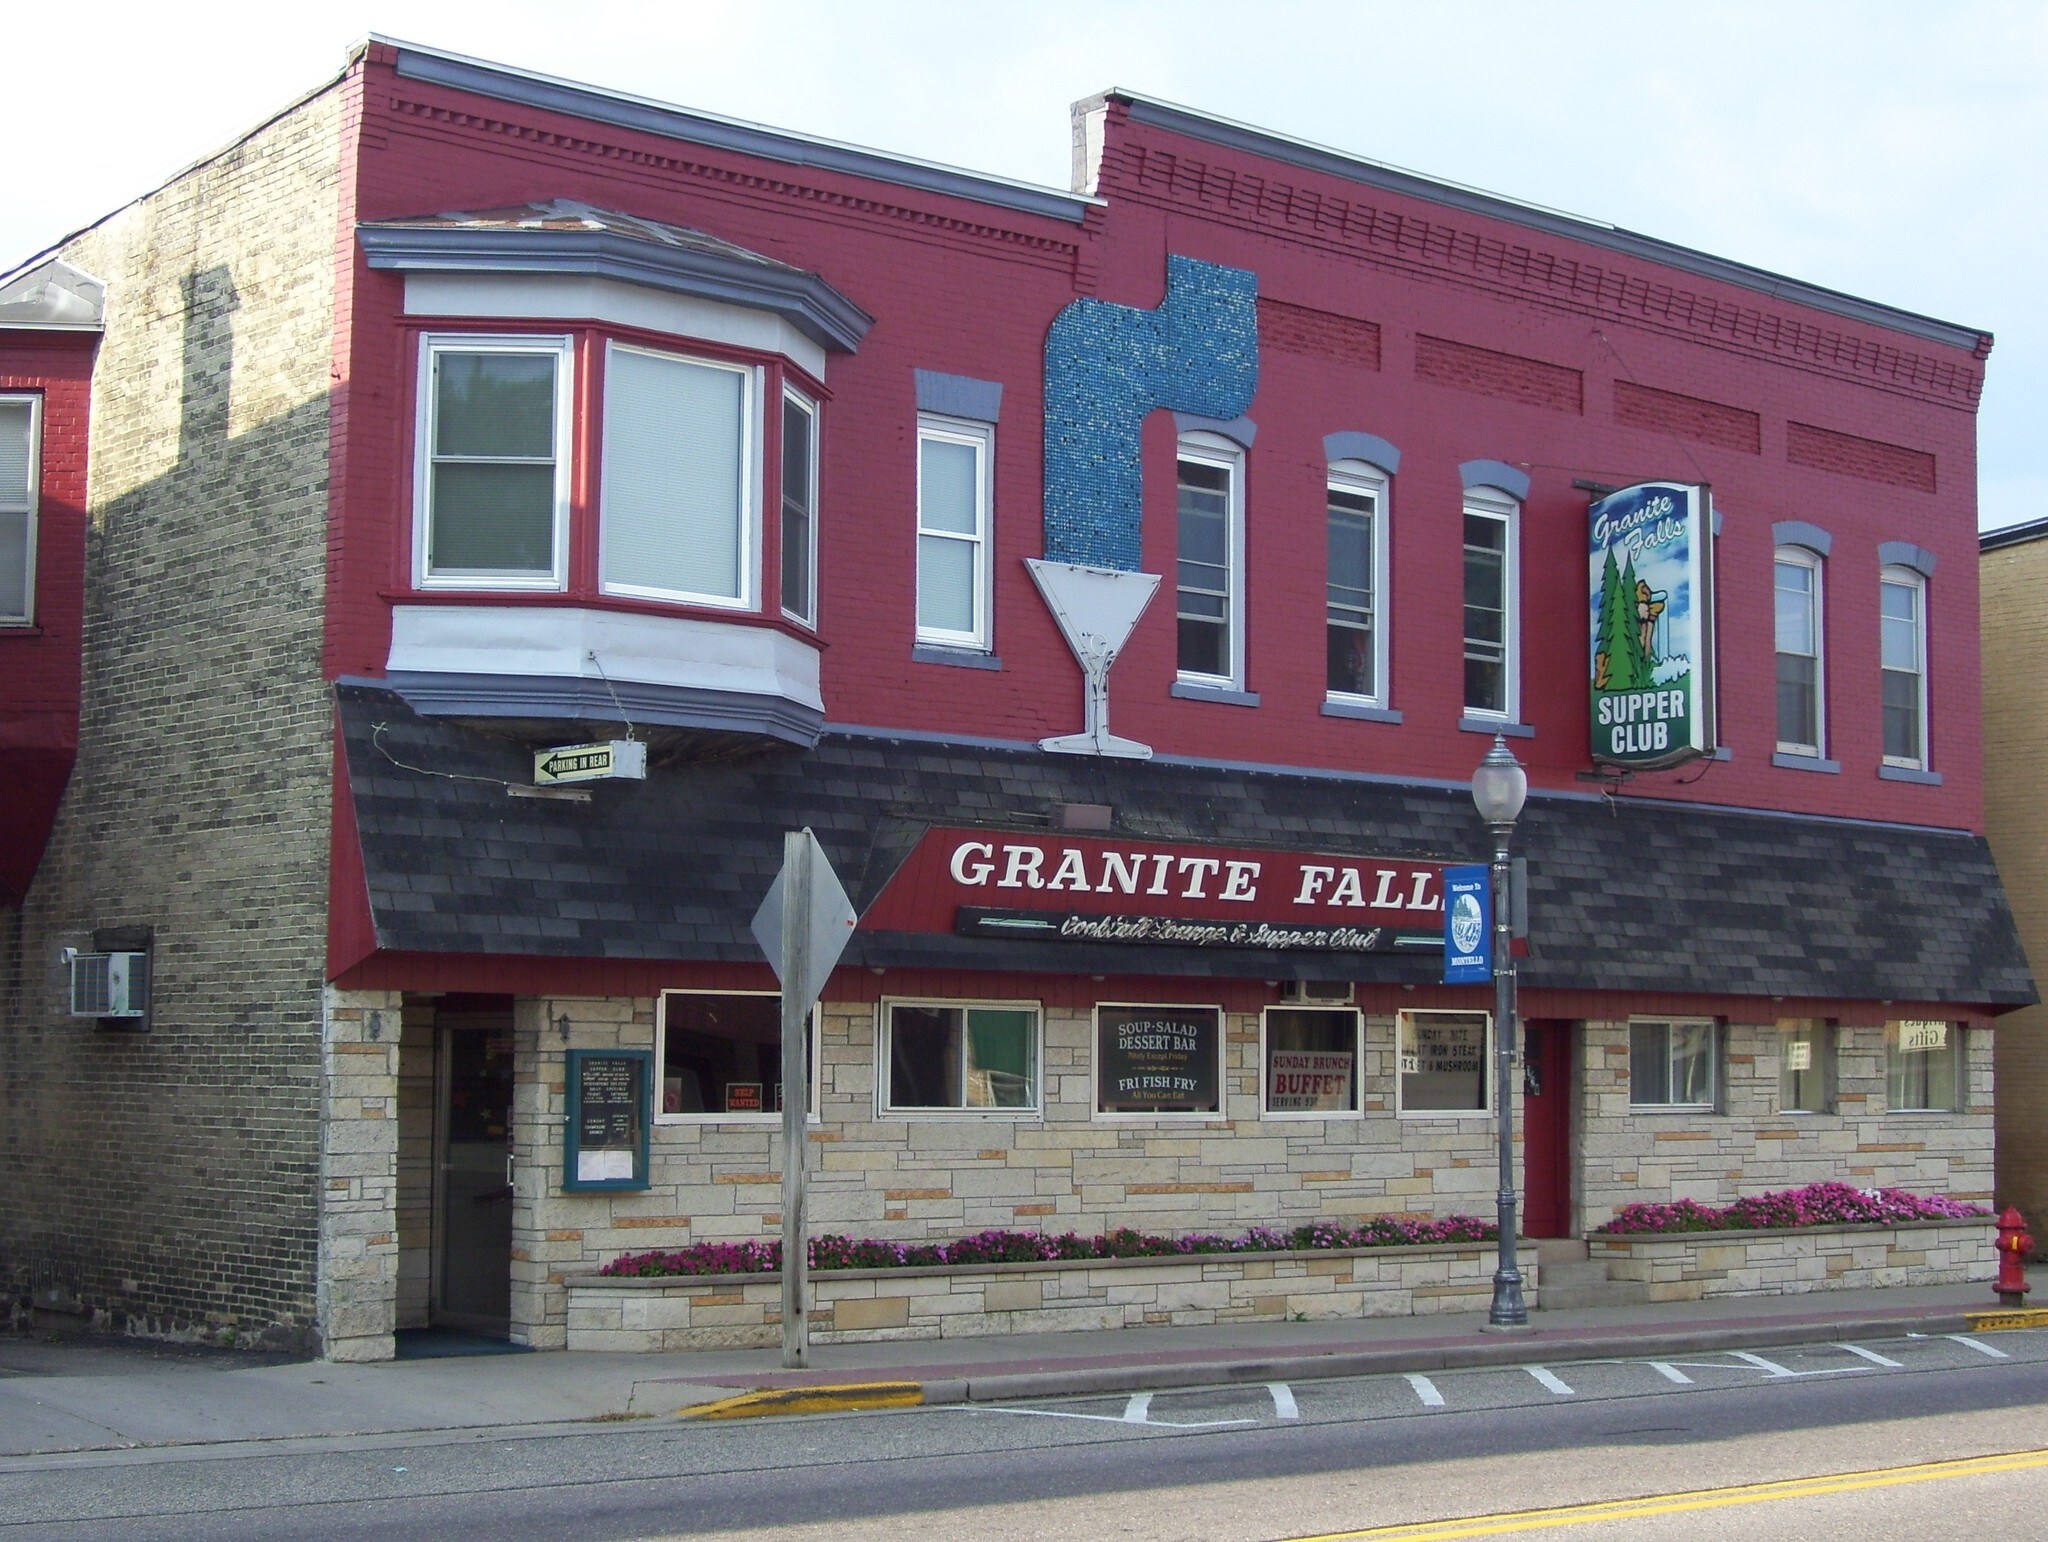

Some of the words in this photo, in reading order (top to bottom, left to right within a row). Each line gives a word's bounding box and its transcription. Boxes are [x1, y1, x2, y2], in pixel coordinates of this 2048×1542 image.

[1594, 494, 1673, 549] Granite
[1623, 516, 1685, 561] Falls
[1598, 689, 1685, 726] SUPPER
[1611, 721, 1668, 755] CLUB
[549, 758, 578, 773] PARKING
[580, 756, 587, 769] IN
[589, 754, 608, 768] REAR
[949, 841, 1261, 902] GRANITE
[1293, 865, 1445, 912] FALL
[1061, 914, 1150, 938] Cocktail
[1152, 918, 1227, 946] Lounge
[1247, 923, 1327, 949] Supper
[1329, 927, 1381, 950] Club
[1451, 956, 1484, 966] MONTELLO
[1118, 1021, 1197, 1036] SOUP-SALAD
[1119, 1035, 1171, 1050] DESSERT
[1174, 1036, 1197, 1051] BAR
[1273, 1056, 1310, 1069] SUNDAY
[1313, 1056, 1350, 1070] BRUNCH
[1119, 1077, 1139, 1091] FRI
[1142, 1076, 1170, 1088] FISH
[1174, 1077, 1198, 1091] FRY
[1275, 1073, 1346, 1095] BUFFET
[734, 1088, 754, 1097] HELP
[1132, 1091, 1142, 1099] All
[1143, 1091, 1156, 1099] You
[1157, 1091, 1171, 1099] Can
[1172, 1091, 1185, 1099] Eat
[729, 1099, 760, 1107] WANTED
[1272, 1096, 1301, 1107] SERVING
